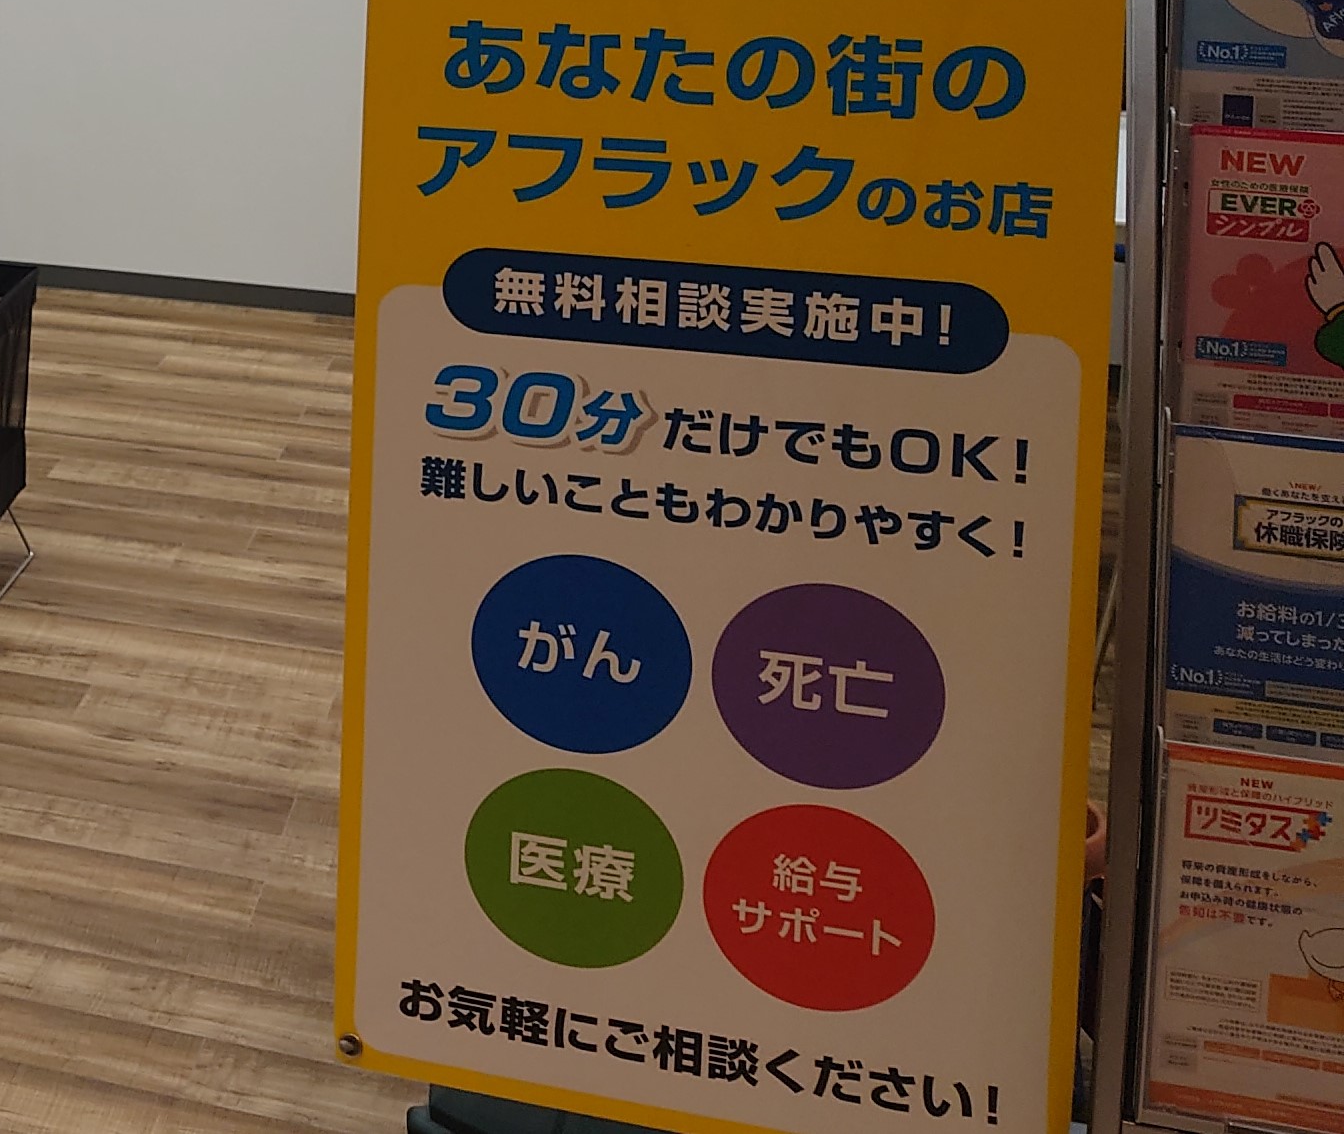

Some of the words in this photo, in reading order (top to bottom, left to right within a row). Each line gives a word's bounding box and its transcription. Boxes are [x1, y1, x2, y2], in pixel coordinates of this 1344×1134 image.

[443, 18, 1027, 121] あなたの街の
[416, 124, 1054, 240] アフラックのお店
[1221, 149, 1305, 176] NEW
[1215, 215, 1303, 237] シンプル
[1221, 193, 1297, 217] EVER
[517, 620, 641, 685] がん
[757, 648, 895, 719] 死亡
[1240, 777, 1274, 789] NEW
[1196, 805, 1292, 841] ツミタス
[509, 831, 636, 902] 医療
[772, 852, 863, 902] 給与
[731, 897, 903, 956] サポート
